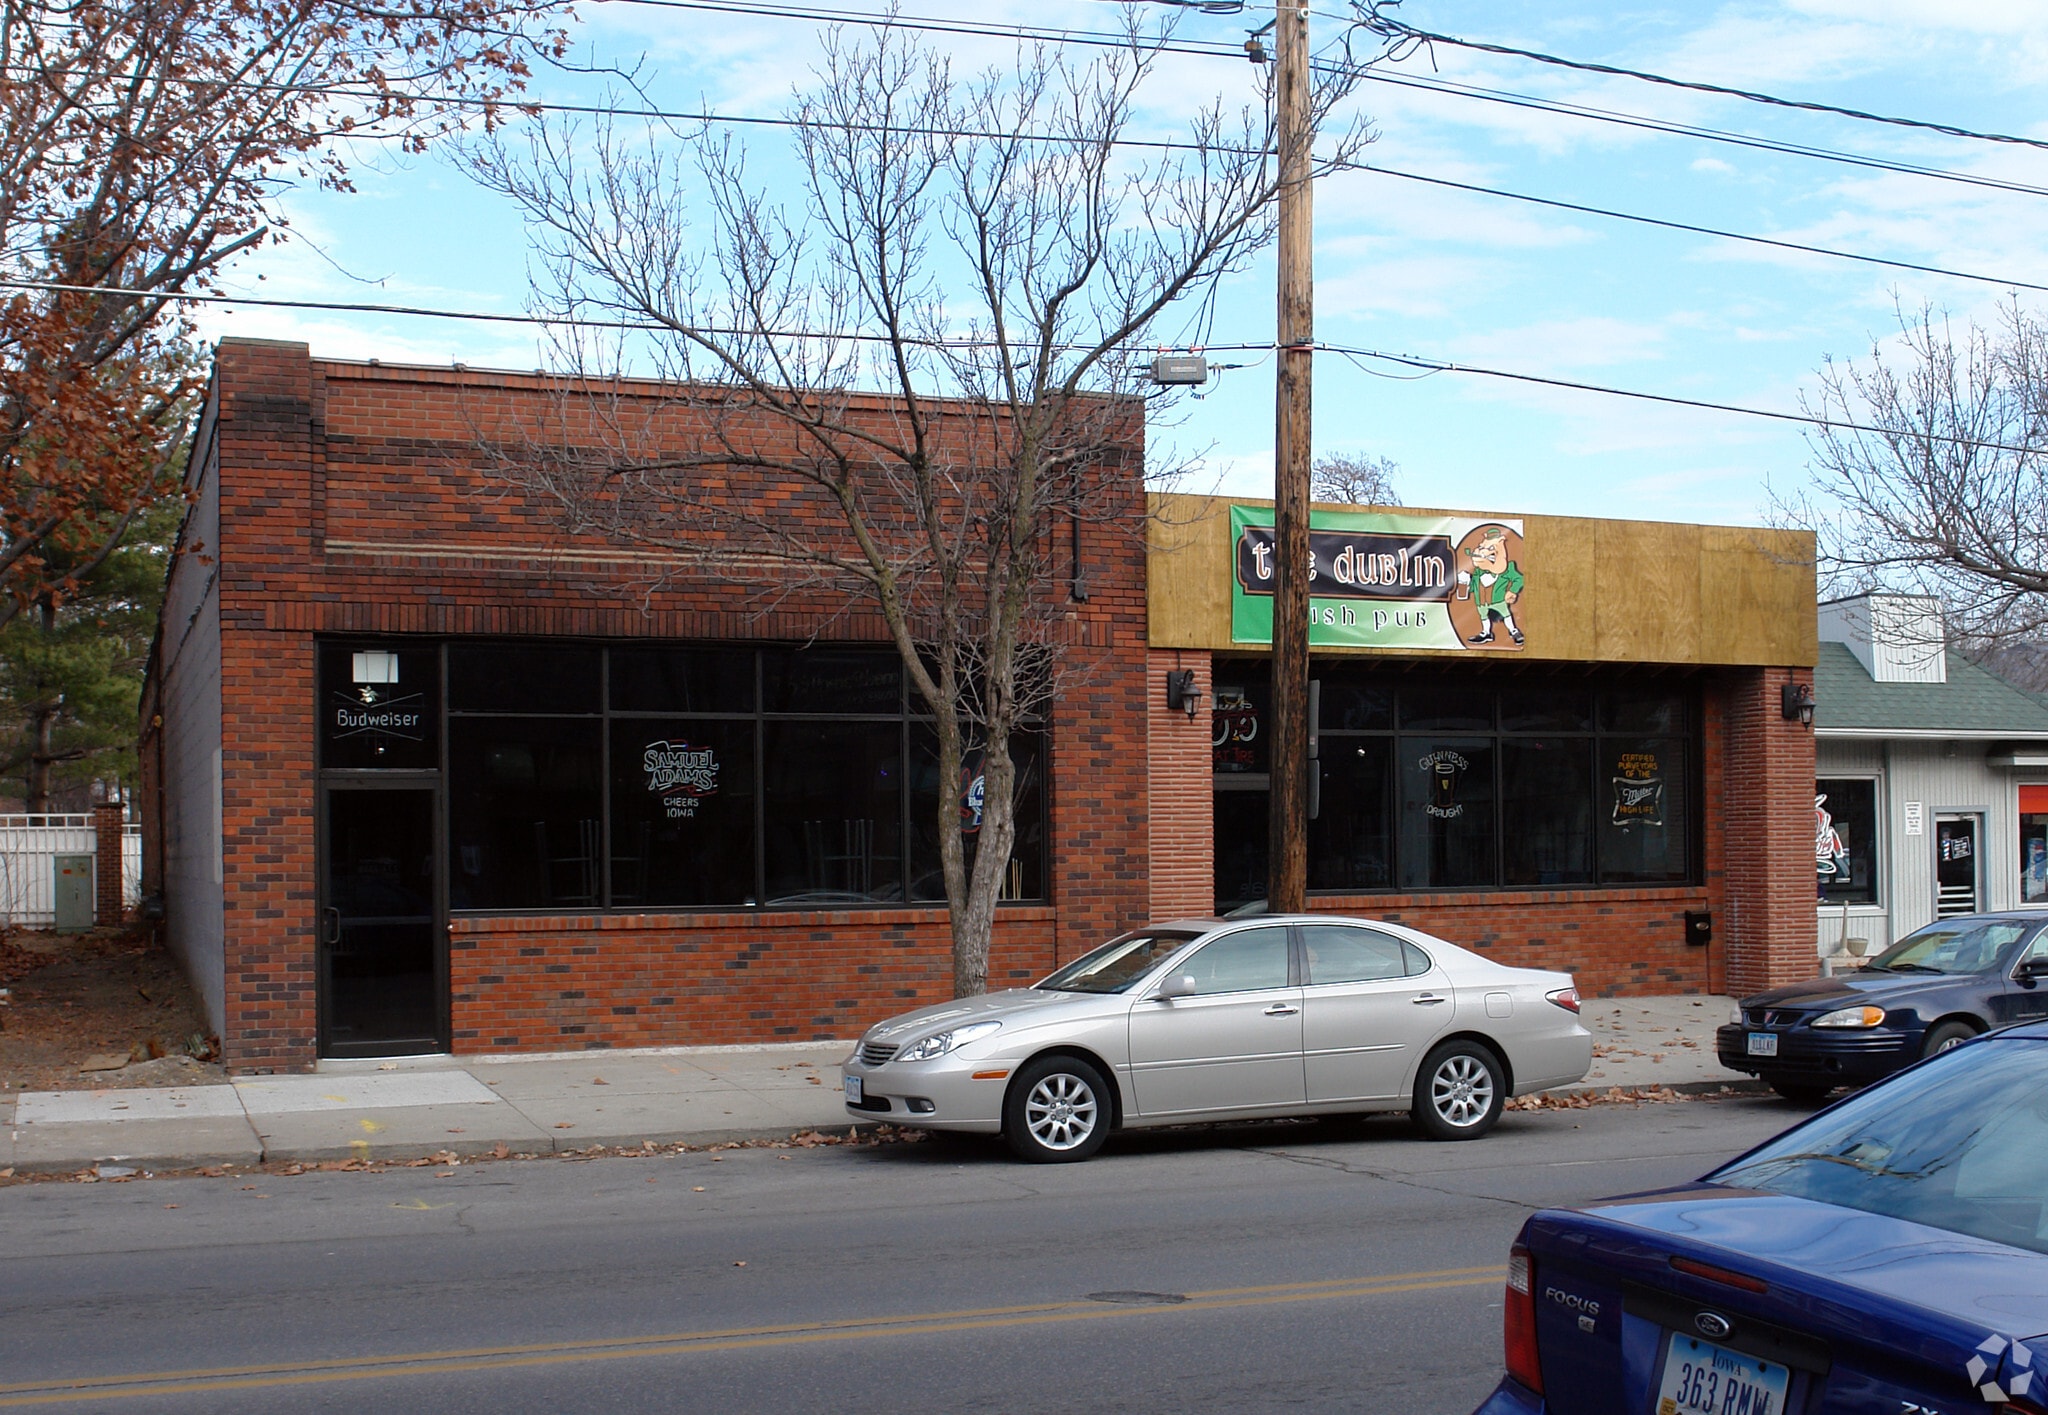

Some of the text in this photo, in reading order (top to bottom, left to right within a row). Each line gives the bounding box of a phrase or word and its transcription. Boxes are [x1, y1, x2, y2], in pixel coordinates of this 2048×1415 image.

[1252, 541, 1317, 581] te
[1311, 604, 1356, 626] ish
[337, 709, 418, 727] Budweiser
[643, 749, 719, 771] SAMUEL
[1211, 750, 1230, 762] AT
[1418, 751, 1469, 771] GUINNESS
[647, 768, 713, 791] ADAMS
[663, 797, 699, 807] CHEERS
[1622, 787, 1653, 806] Miller
[666, 807, 694, 818] IOWA
[1426, 804, 1463, 818] DRAUGHT
[1545, 1286, 1600, 1316] FOCUS
[1676, 1362, 1770, 1415] 363 RMW
